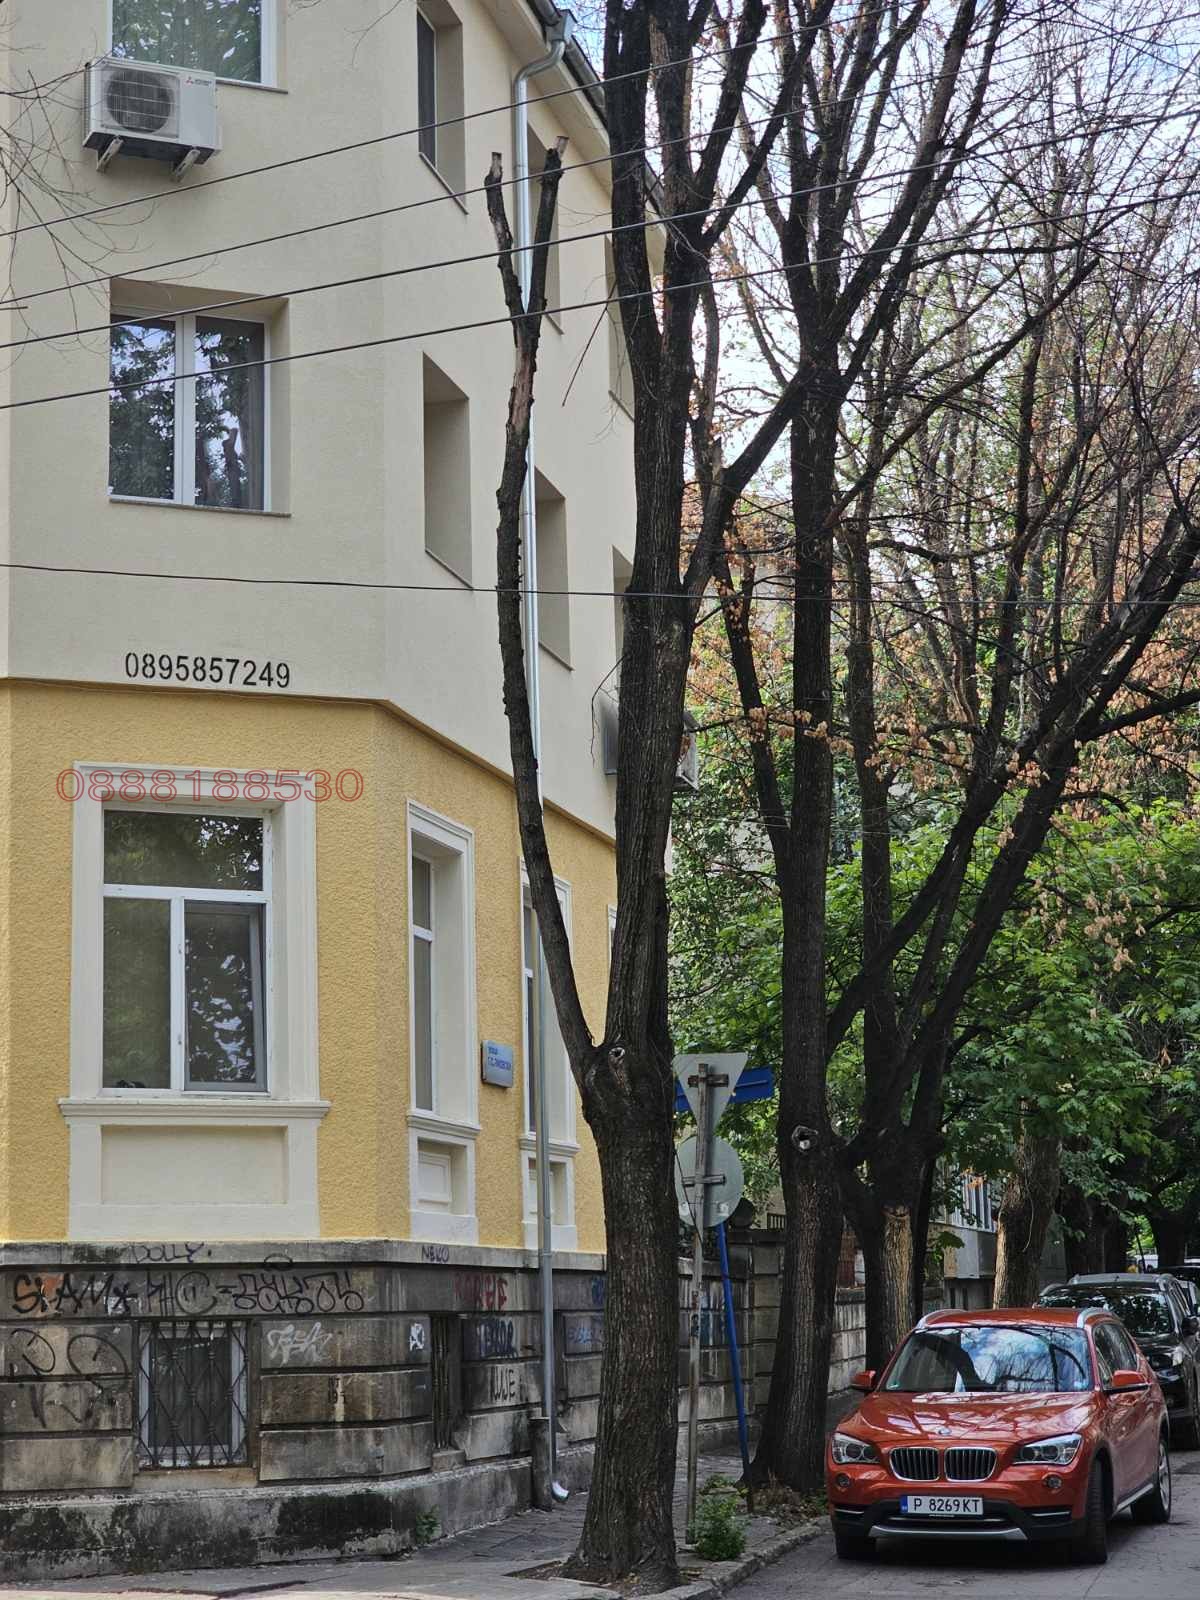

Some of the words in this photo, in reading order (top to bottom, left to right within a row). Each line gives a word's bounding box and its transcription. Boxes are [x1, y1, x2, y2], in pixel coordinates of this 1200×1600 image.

[913, 1498, 922, 1511] P
[929, 1498, 961, 1512] 8269
[962, 1499, 980, 1513] KT
